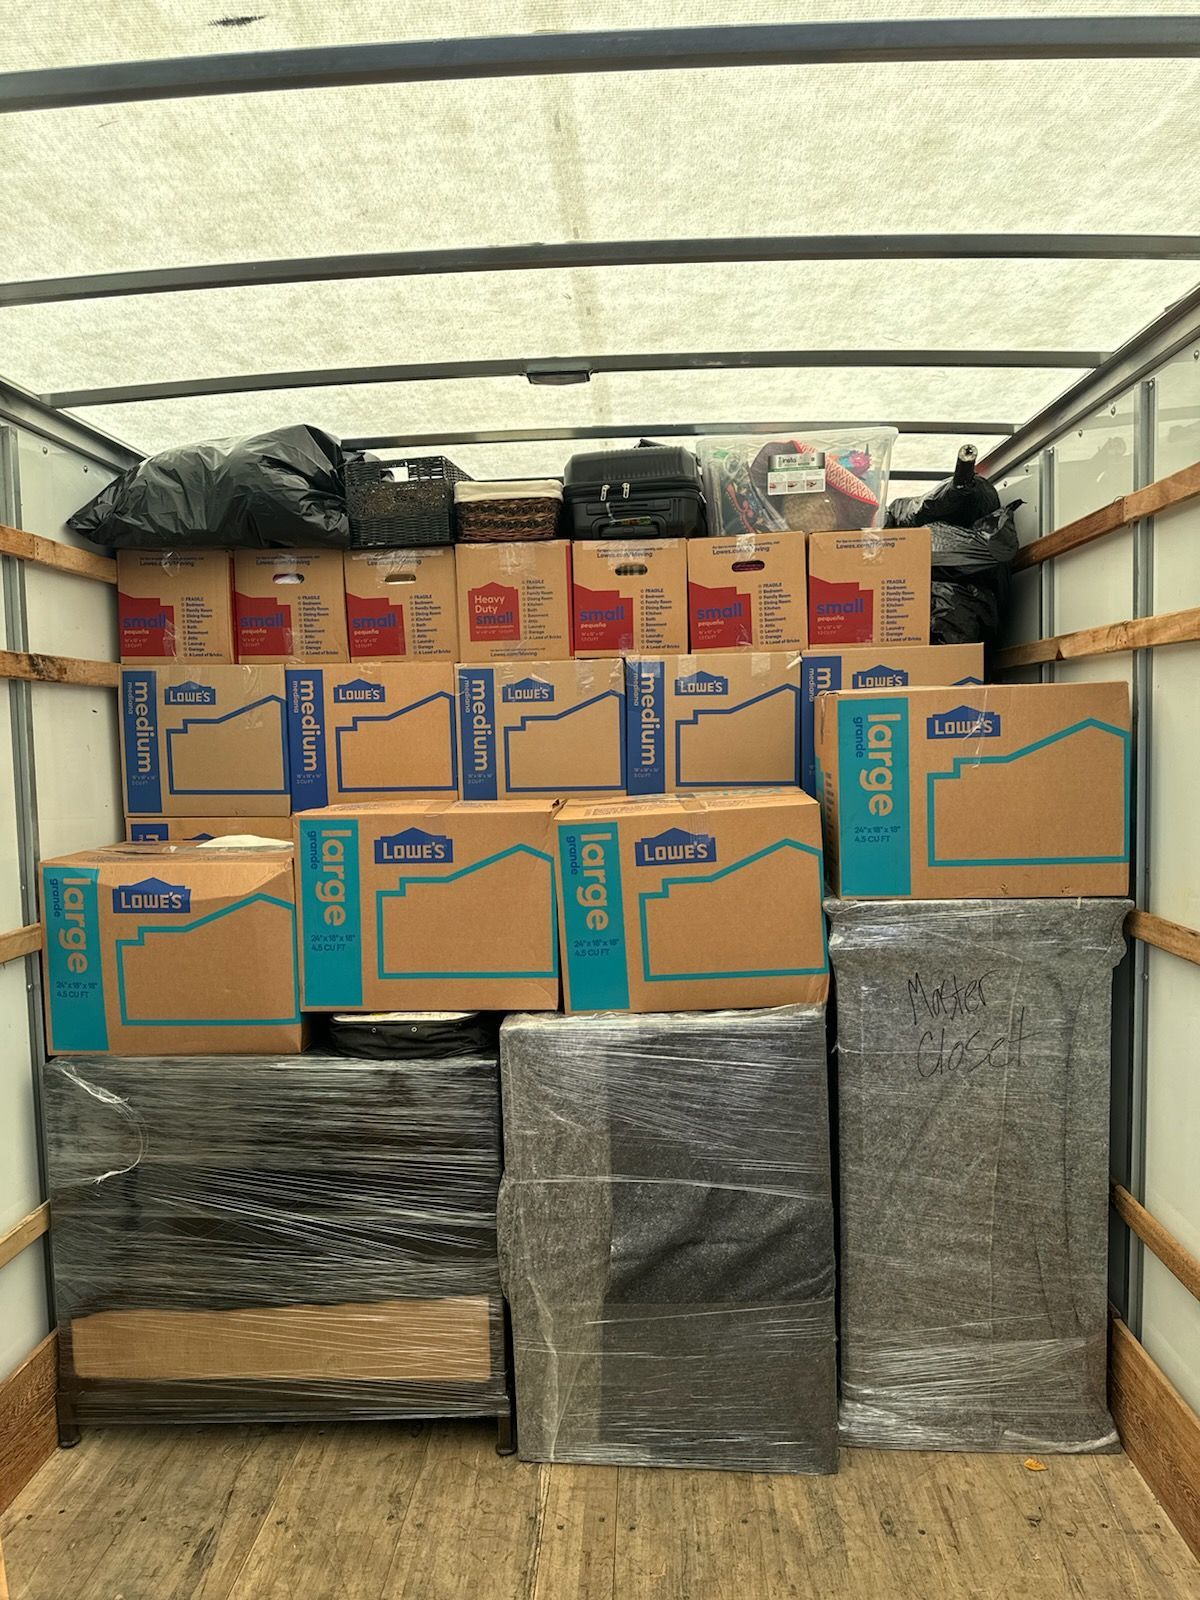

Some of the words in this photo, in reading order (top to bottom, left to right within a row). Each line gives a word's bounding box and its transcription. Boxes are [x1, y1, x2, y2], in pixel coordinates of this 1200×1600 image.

[475, 595, 505, 603] Heavy
[817, 598, 864, 615] small
[475, 606, 498, 614] Duty
[476, 612, 513, 624] small
[580, 605, 624, 621] small
[698, 601, 742, 619] small
[124, 611, 165, 628] small
[240, 612, 284, 627] small
[352, 613, 396, 629] small
[680, 681, 722, 693] LOWE'S
[858, 674, 903, 688] LOWE'S
[170, 690, 211, 702] LOWE'S
[339, 688, 380, 700] LOWE'S
[508, 687, 549, 699] LOWE'S
[135, 681, 154, 772] medium
[301, 680, 320, 771] medium
[472, 680, 492, 771] medium
[641, 673, 660, 765] medium
[853, 716, 866, 758] grande
[859, 714, 901, 816] large
[308, 831, 319, 869] grande
[383, 842, 445, 859] LOWE'S
[567, 836, 580, 875] grande
[644, 842, 707, 861] LOWE'S
[316, 830, 352, 926] large
[577, 833, 612, 931] large
[50, 879, 62, 917] grande
[121, 891, 181, 909] LOWE'S
[59, 878, 91, 973] large
[909, 970, 1000, 1025] Master
[918, 1007, 1043, 1078] Closet
